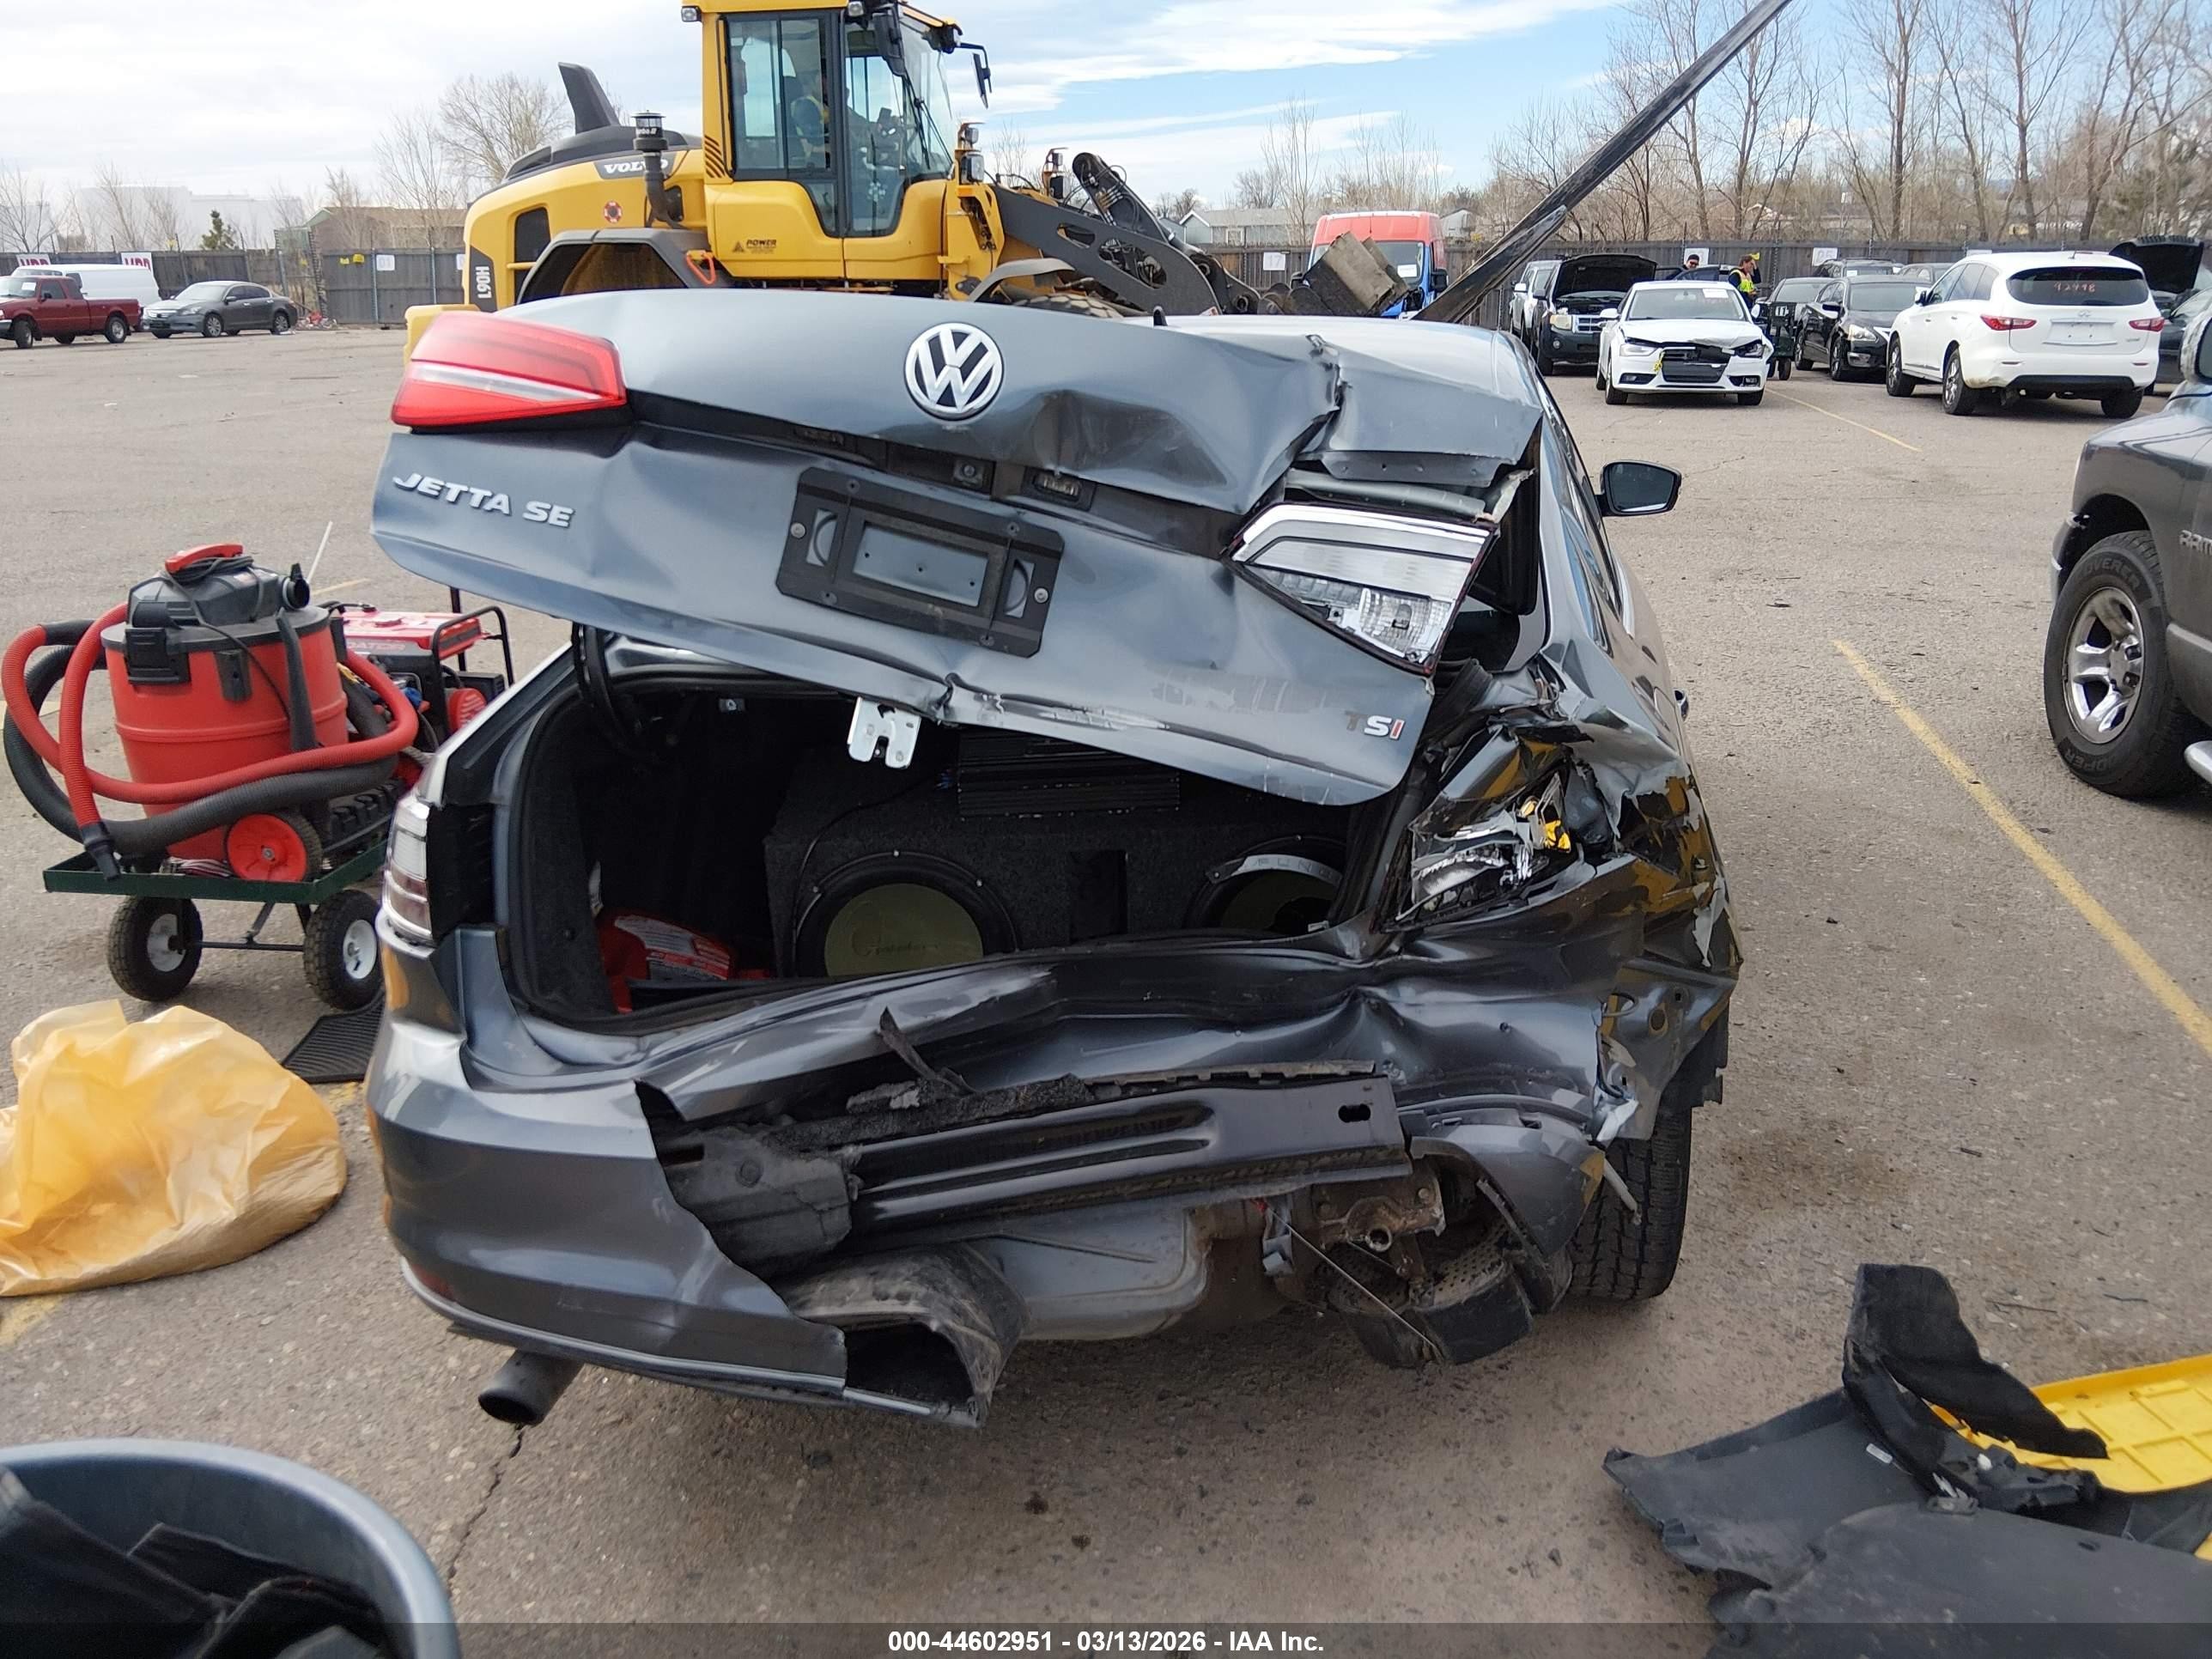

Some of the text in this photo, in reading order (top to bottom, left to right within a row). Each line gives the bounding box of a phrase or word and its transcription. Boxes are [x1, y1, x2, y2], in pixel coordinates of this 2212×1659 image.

[475, 266, 492, 299] L90H
[392, 472, 574, 528] JETTA SE
[1345, 710, 1406, 740] TSI
